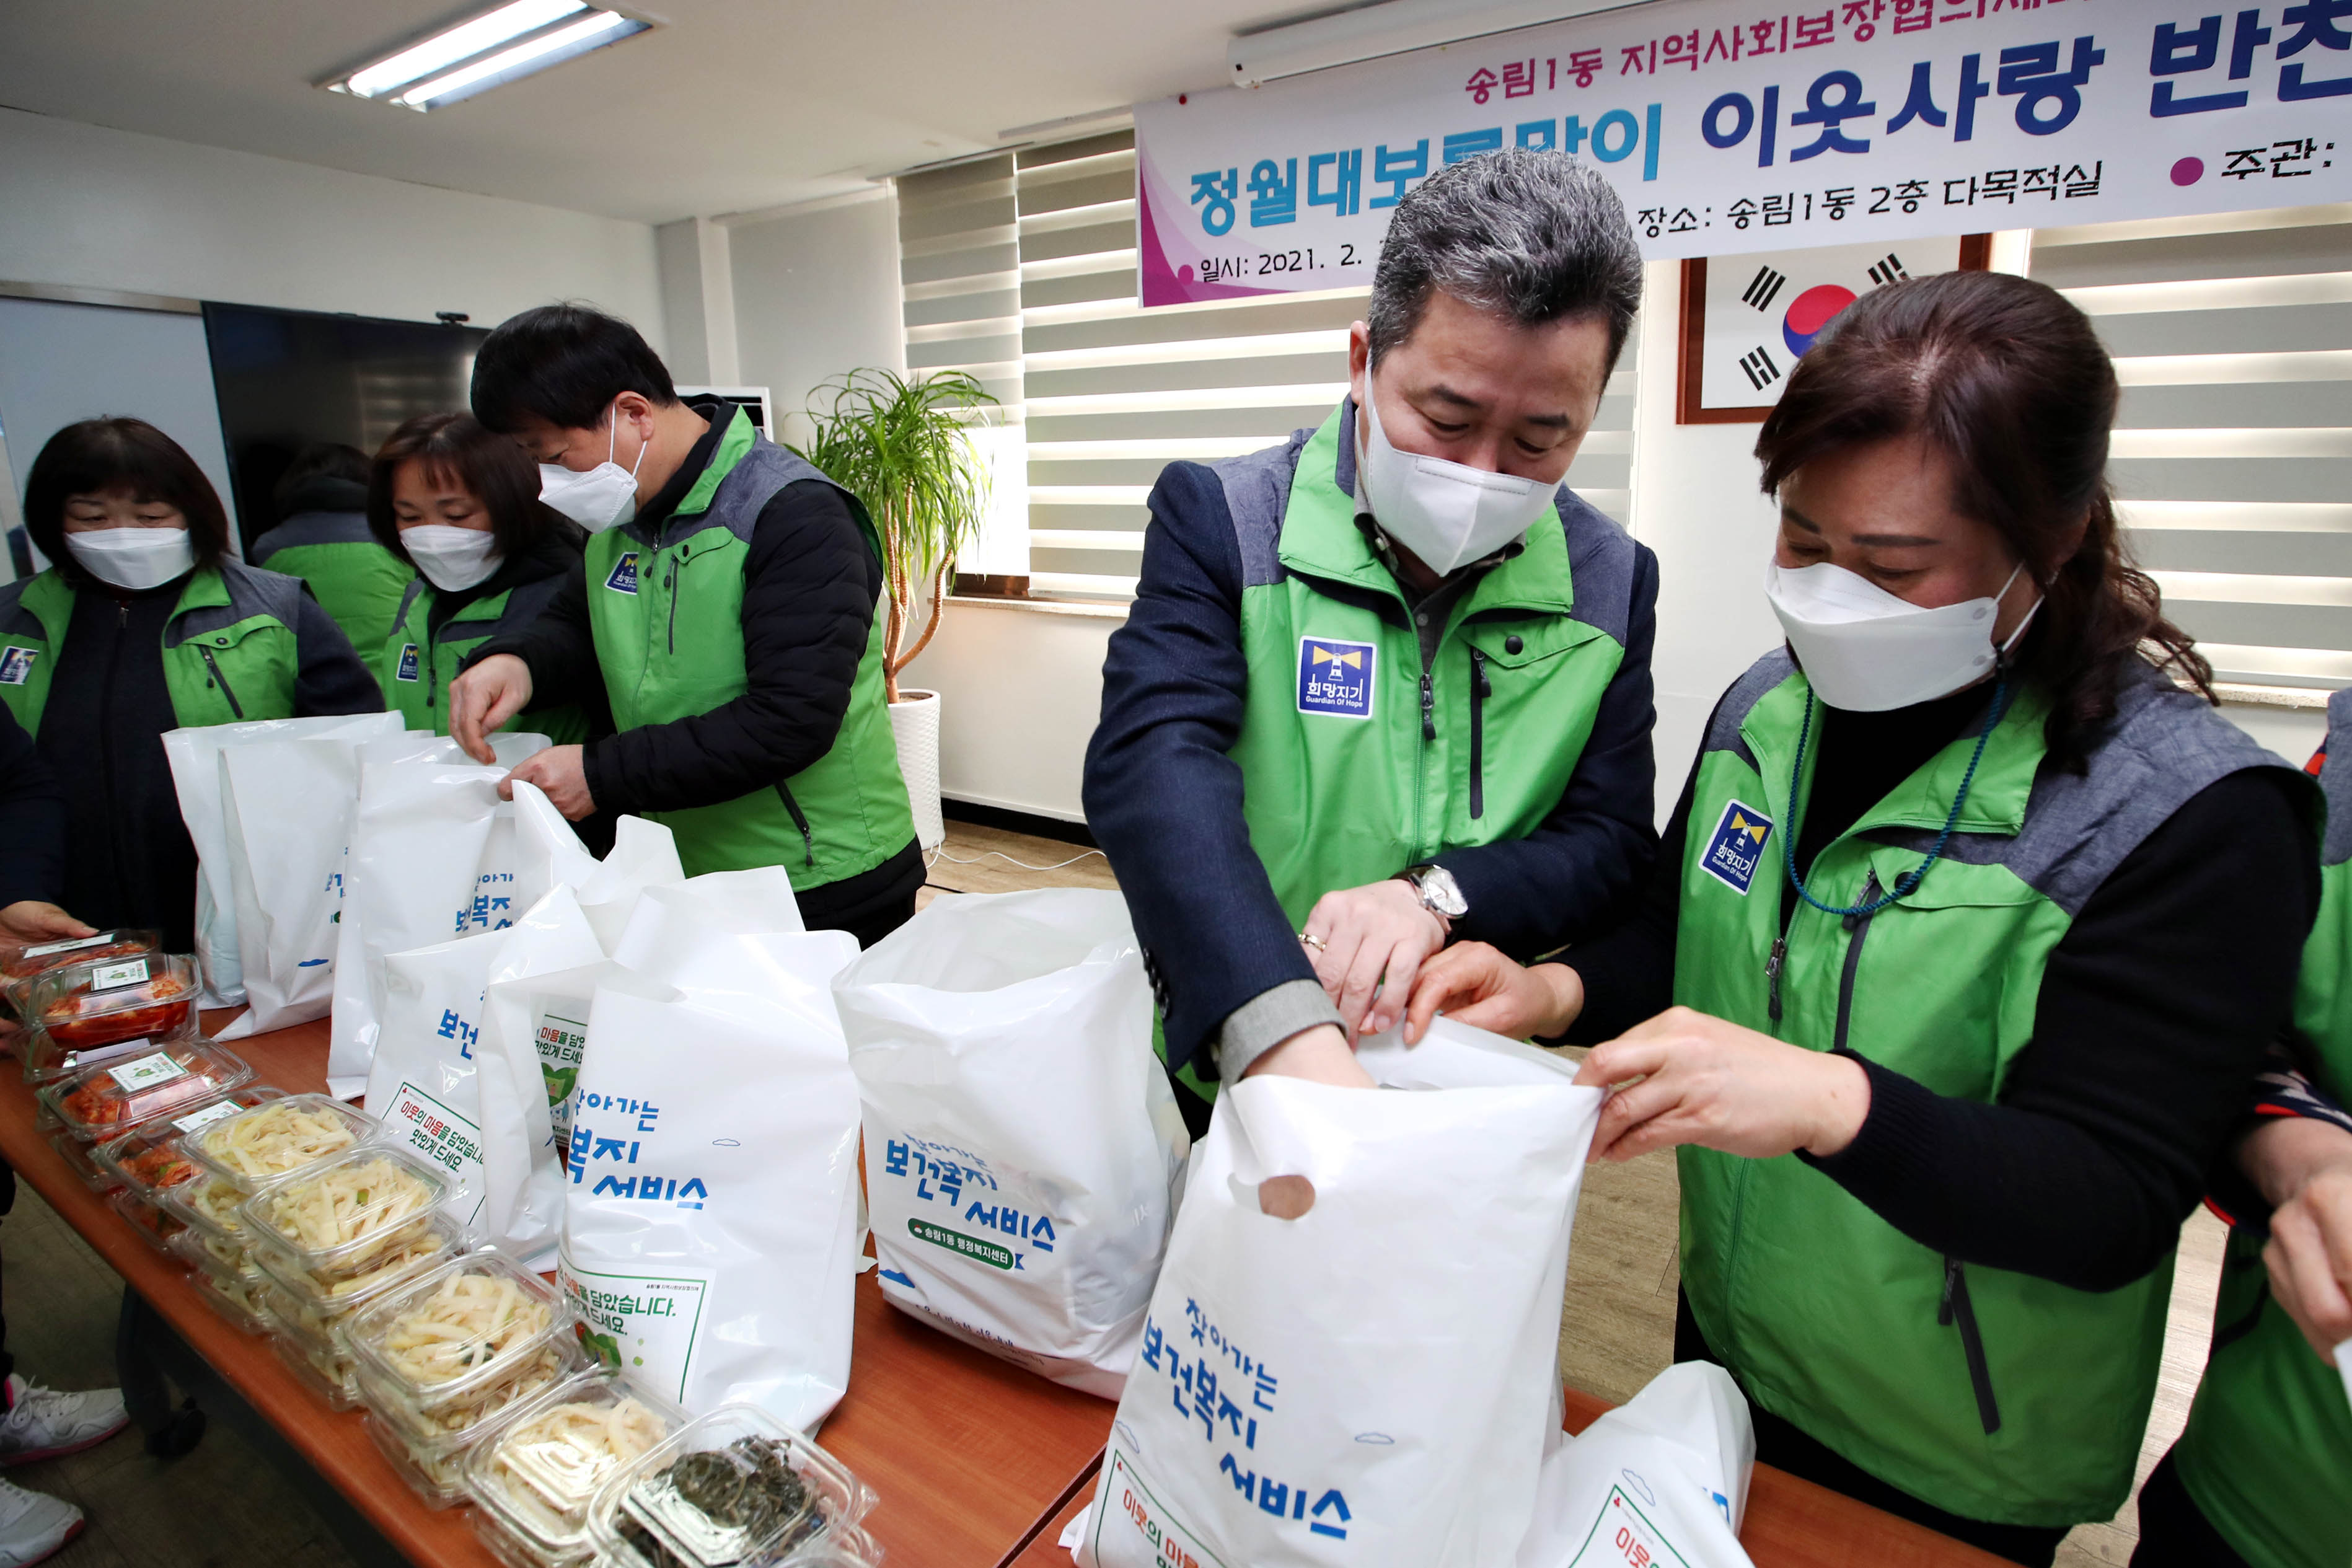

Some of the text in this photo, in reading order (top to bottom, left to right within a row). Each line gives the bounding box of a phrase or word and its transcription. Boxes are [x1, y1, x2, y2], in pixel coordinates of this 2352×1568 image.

[1466, 0, 2090, 105] 송림1동 지역사회보장협의
[1701, 35, 2105, 168] 이웃사랑
[2221, 138, 2335, 180] 주관:
[1638, 161, 2103, 239] 장소: 송림1동 2층 다목적실
[1200, 245, 1363, 283] 일시: 2021. 2.
[1306, 695, 1335, 705] Guardian
[1346, 700, 1363, 708] Hope
[1307, 674, 1363, 701] 희망지기
[1716, 838, 1756, 876] 희망지기
[540, 1027, 568, 1045] 마음을
[401, 1101, 427, 1125] 이웃의
[423, 1116, 451, 1142] 마음을
[409, 1129, 462, 1173] 맛있게 드세요.
[592, 1175, 708, 1210] 서비스
[886, 1139, 998, 1207] 보건복지
[925, 1228, 1009, 1265] 송림1동 행정복지센터
[965, 1201, 1055, 1253] 서비스
[590, 1290, 677, 1316] 담았습니다.
[591, 1308, 628, 1336] 드세요.
[1186, 1297, 1277, 1412] 찾아가는
[1142, 1315, 1257, 1450] 보건복지
[1220, 1453, 1352, 1540] 서비스
[1124, 1489, 1161, 1549] 이웃의
[1616, 1527, 1659, 1568] 이웃
